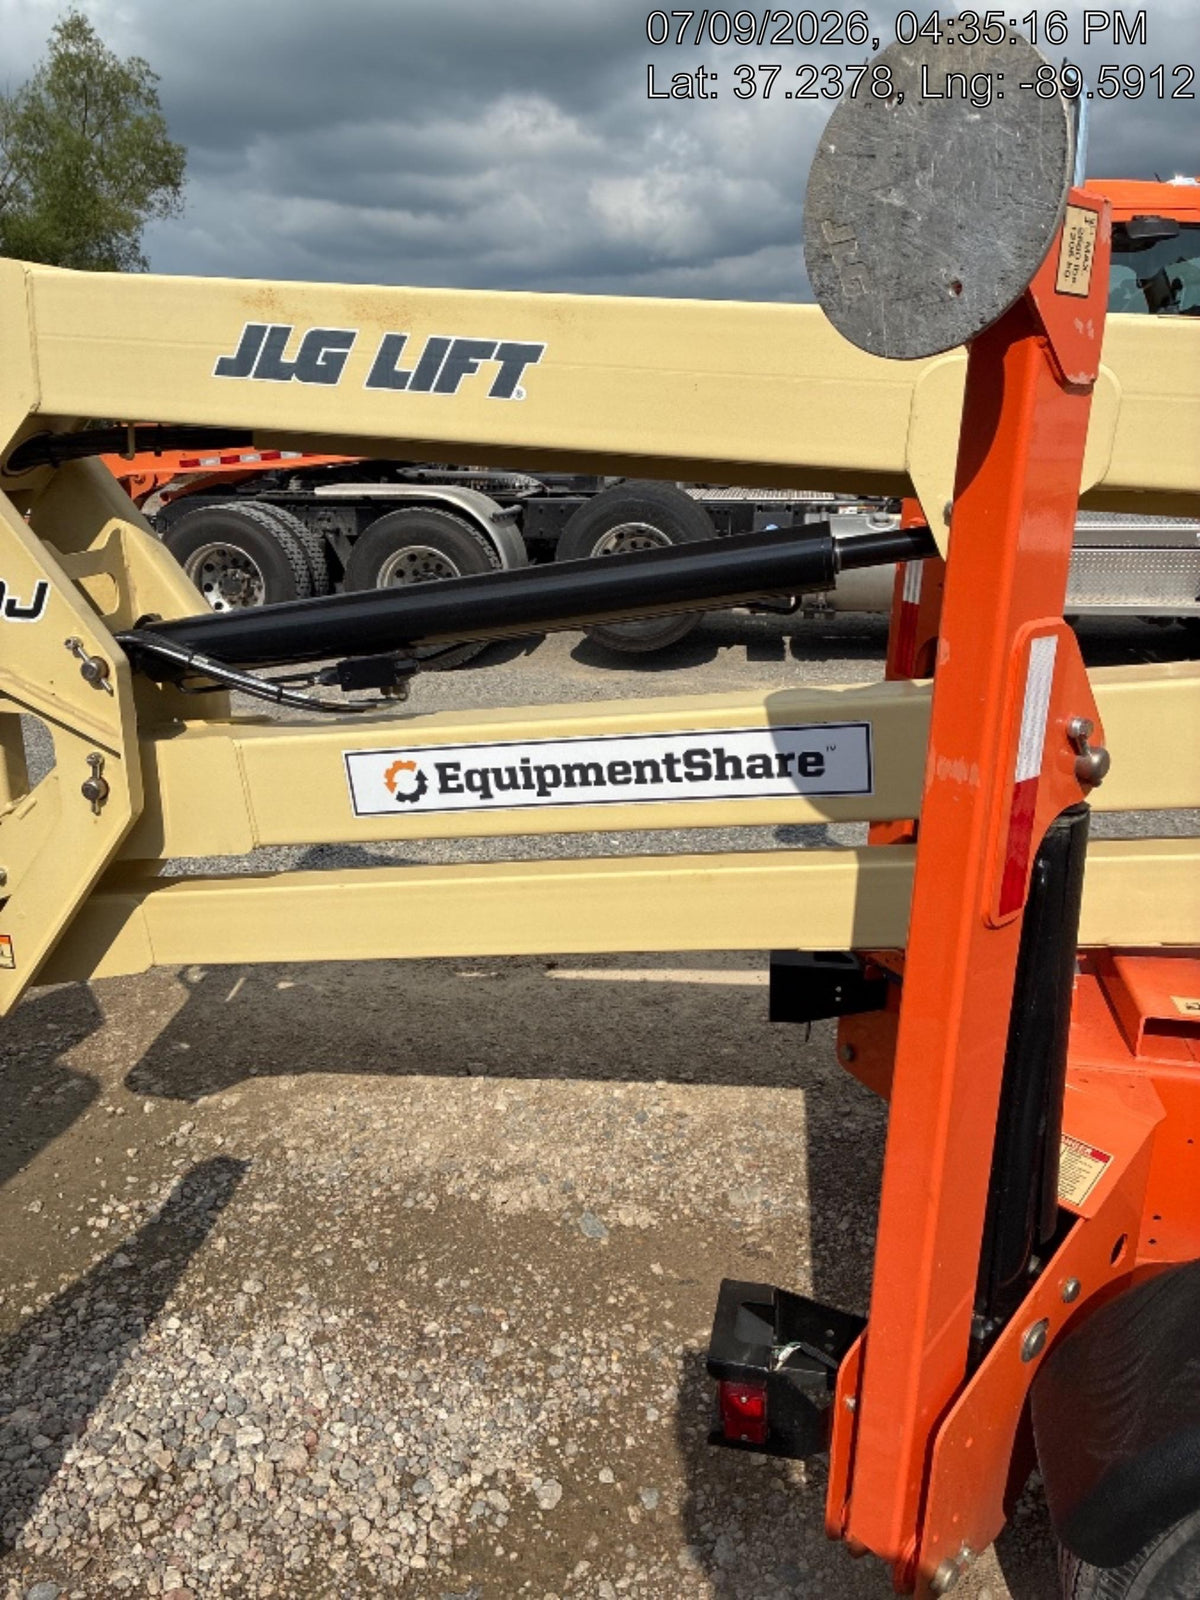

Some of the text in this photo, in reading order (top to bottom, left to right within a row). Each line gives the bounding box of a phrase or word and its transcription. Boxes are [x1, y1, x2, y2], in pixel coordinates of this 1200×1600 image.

[213, 323, 547, 399] JLG LIFT
[434, 747, 826, 800] EquipmentShare
